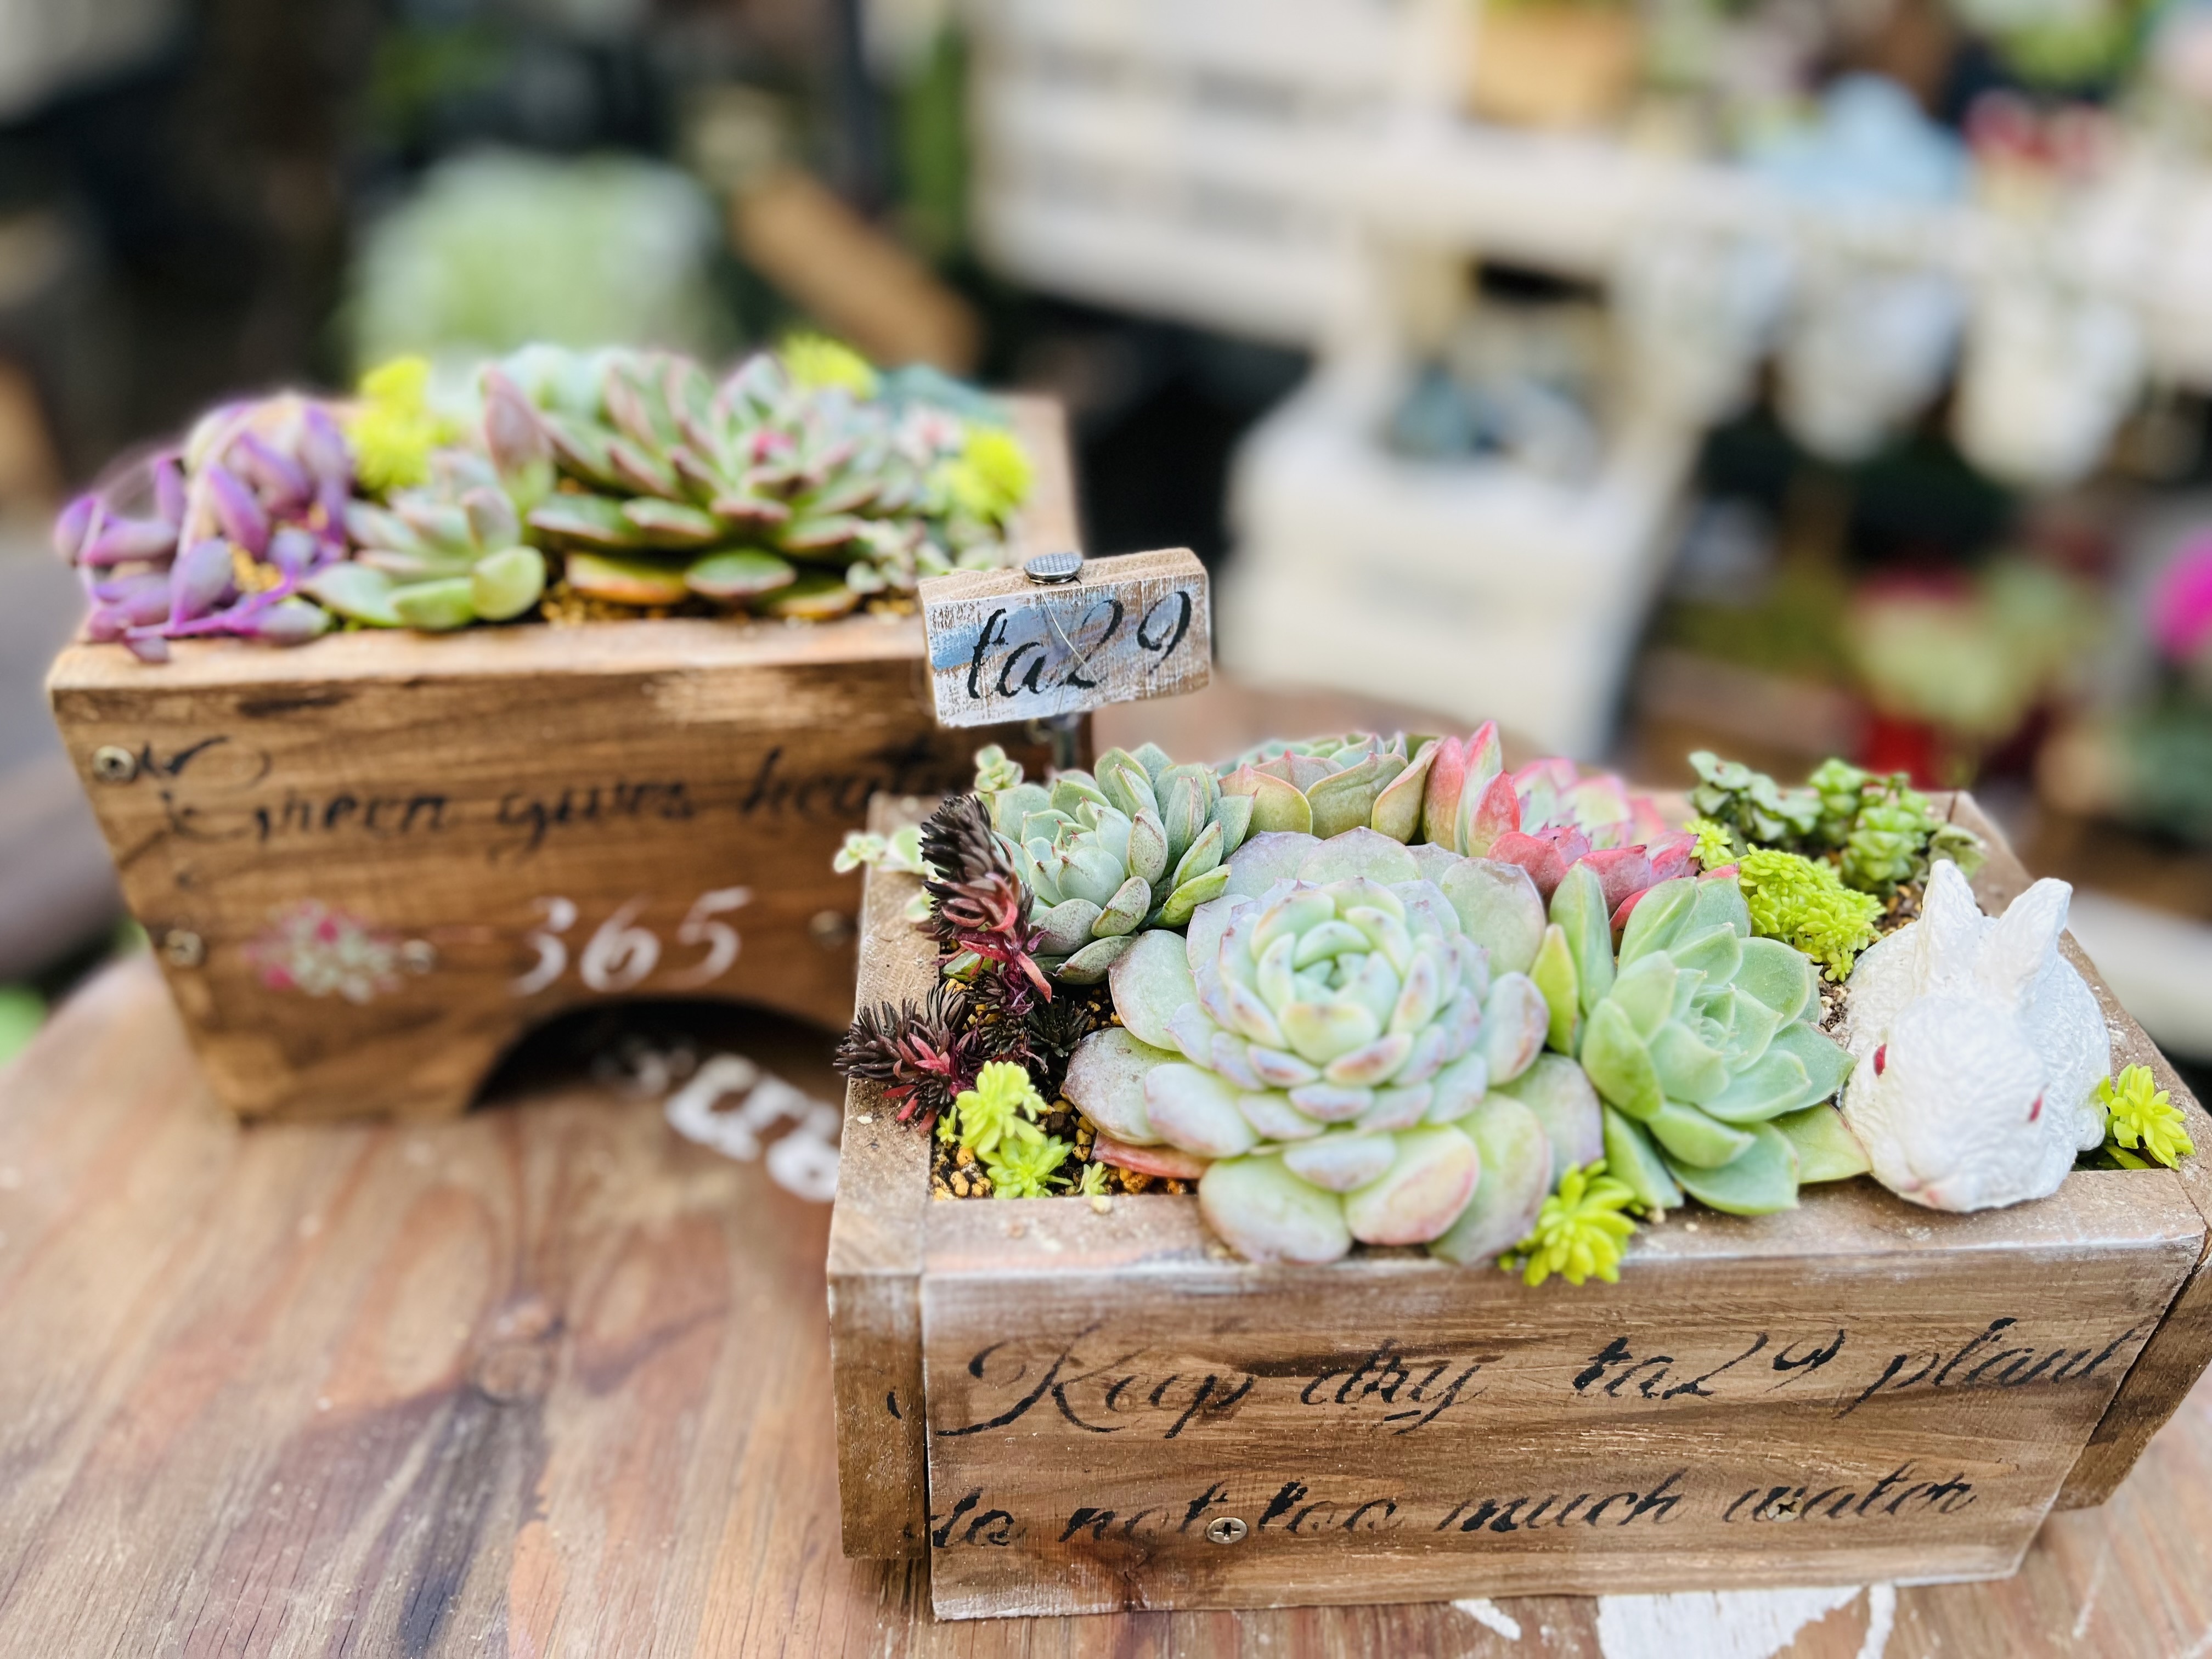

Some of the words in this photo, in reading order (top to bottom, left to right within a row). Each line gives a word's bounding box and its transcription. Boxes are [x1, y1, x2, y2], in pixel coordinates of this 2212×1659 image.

[967, 590, 1192, 700] ta29
[507, 885, 753, 996] 365
[934, 1319, 1256, 1438] Keep
[1300, 1336, 1489, 1436] dry
[1058, 1480, 1229, 1542] not
[1434, 1467, 1688, 1533] much
[1722, 1458, 1977, 1523] water
